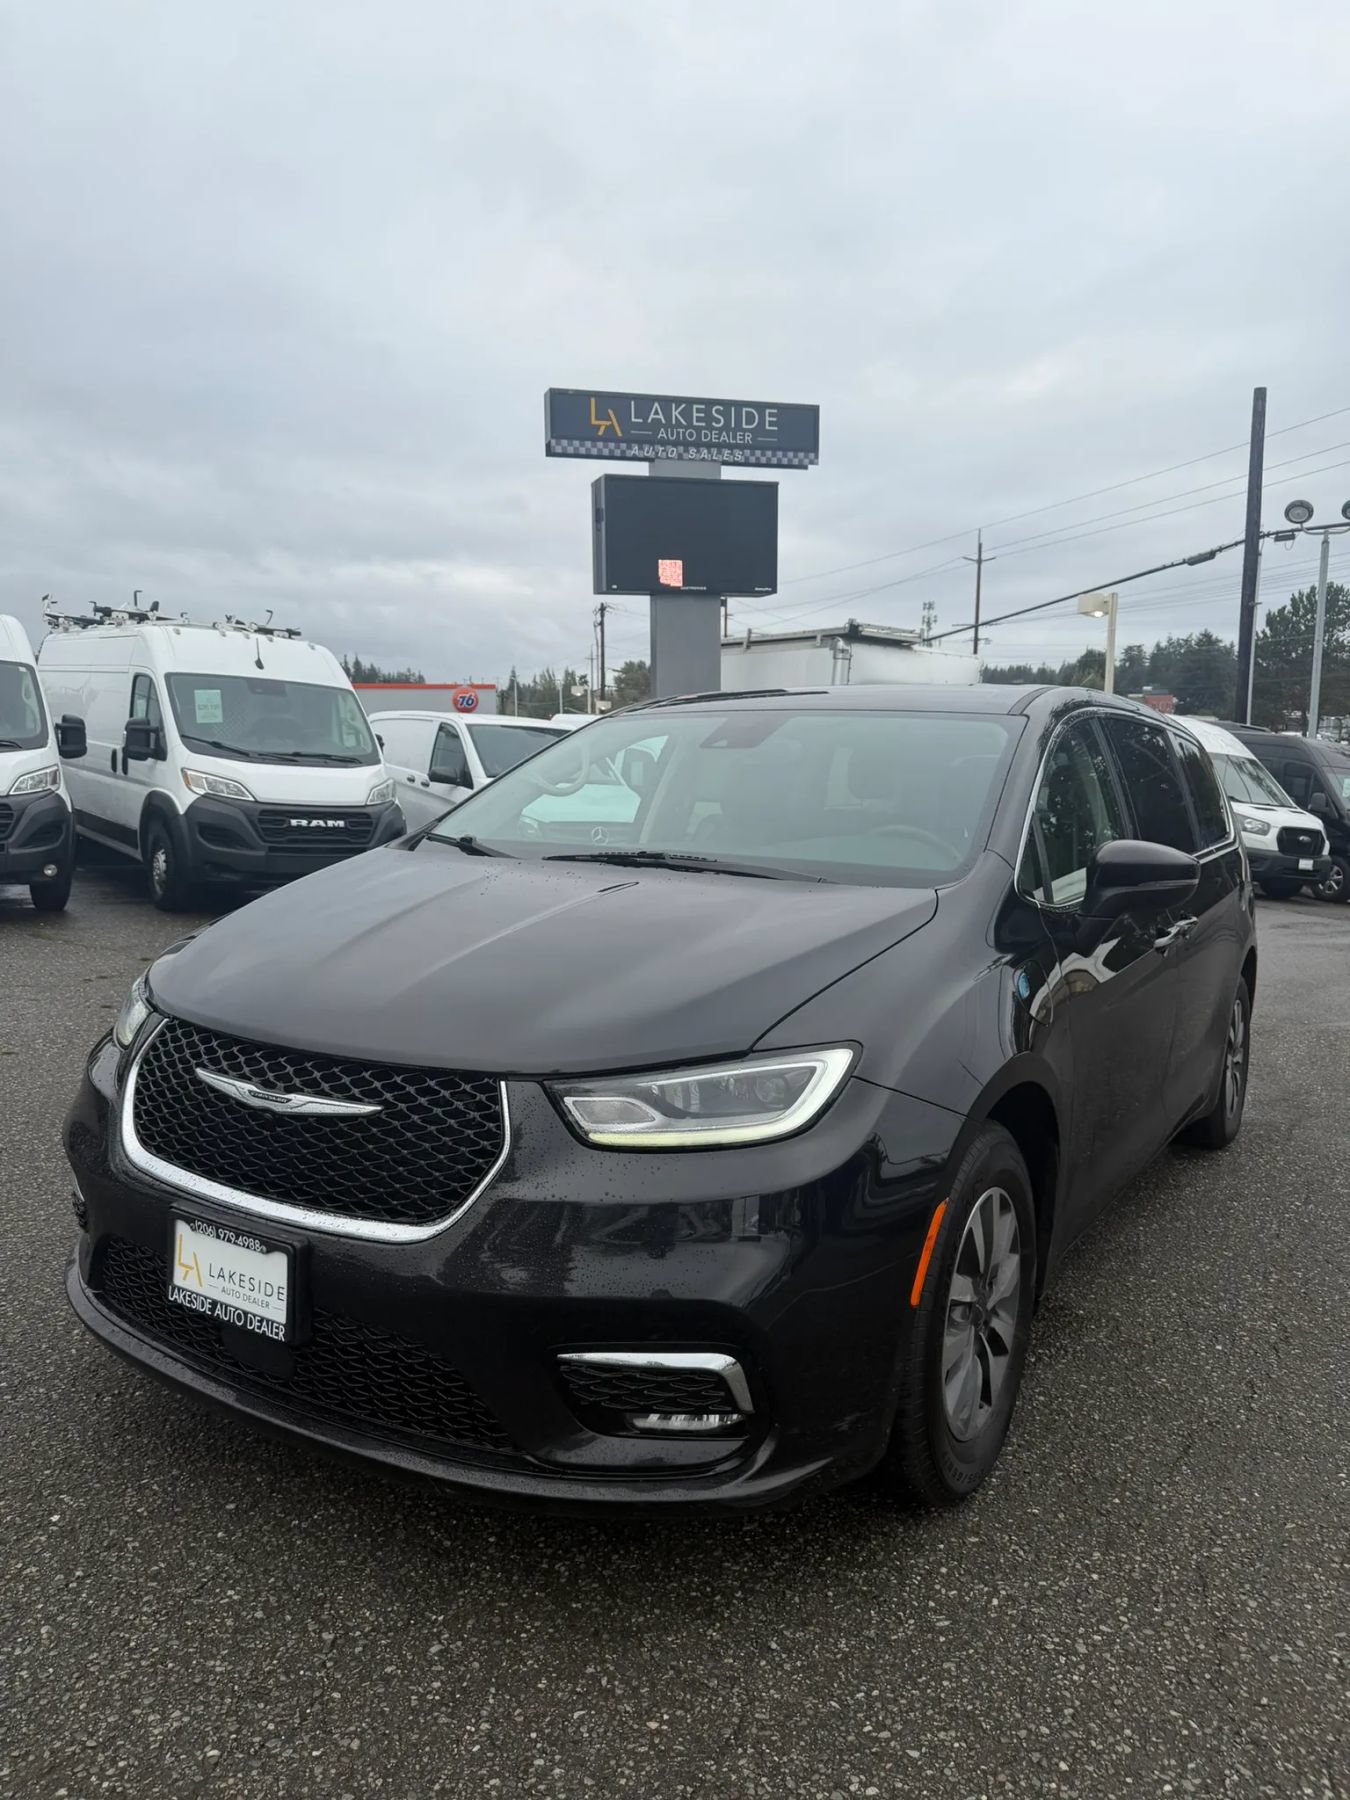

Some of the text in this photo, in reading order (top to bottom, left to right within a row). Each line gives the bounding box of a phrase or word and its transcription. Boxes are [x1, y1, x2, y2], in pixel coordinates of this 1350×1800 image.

[630, 400, 779, 431] LAKESIDE
[657, 428, 753, 444] AUTO DEALER
[630, 446, 744, 461] AUTO SALES
[458, 694, 475, 707] 76
[290, 819, 345, 828] RAM
[208, 1263, 286, 1302] LAKESIDE
[221, 1286, 270, 1310] AUTO DEALER
[168, 1285, 286, 1342] LAKESIDE AUTO DEALER
